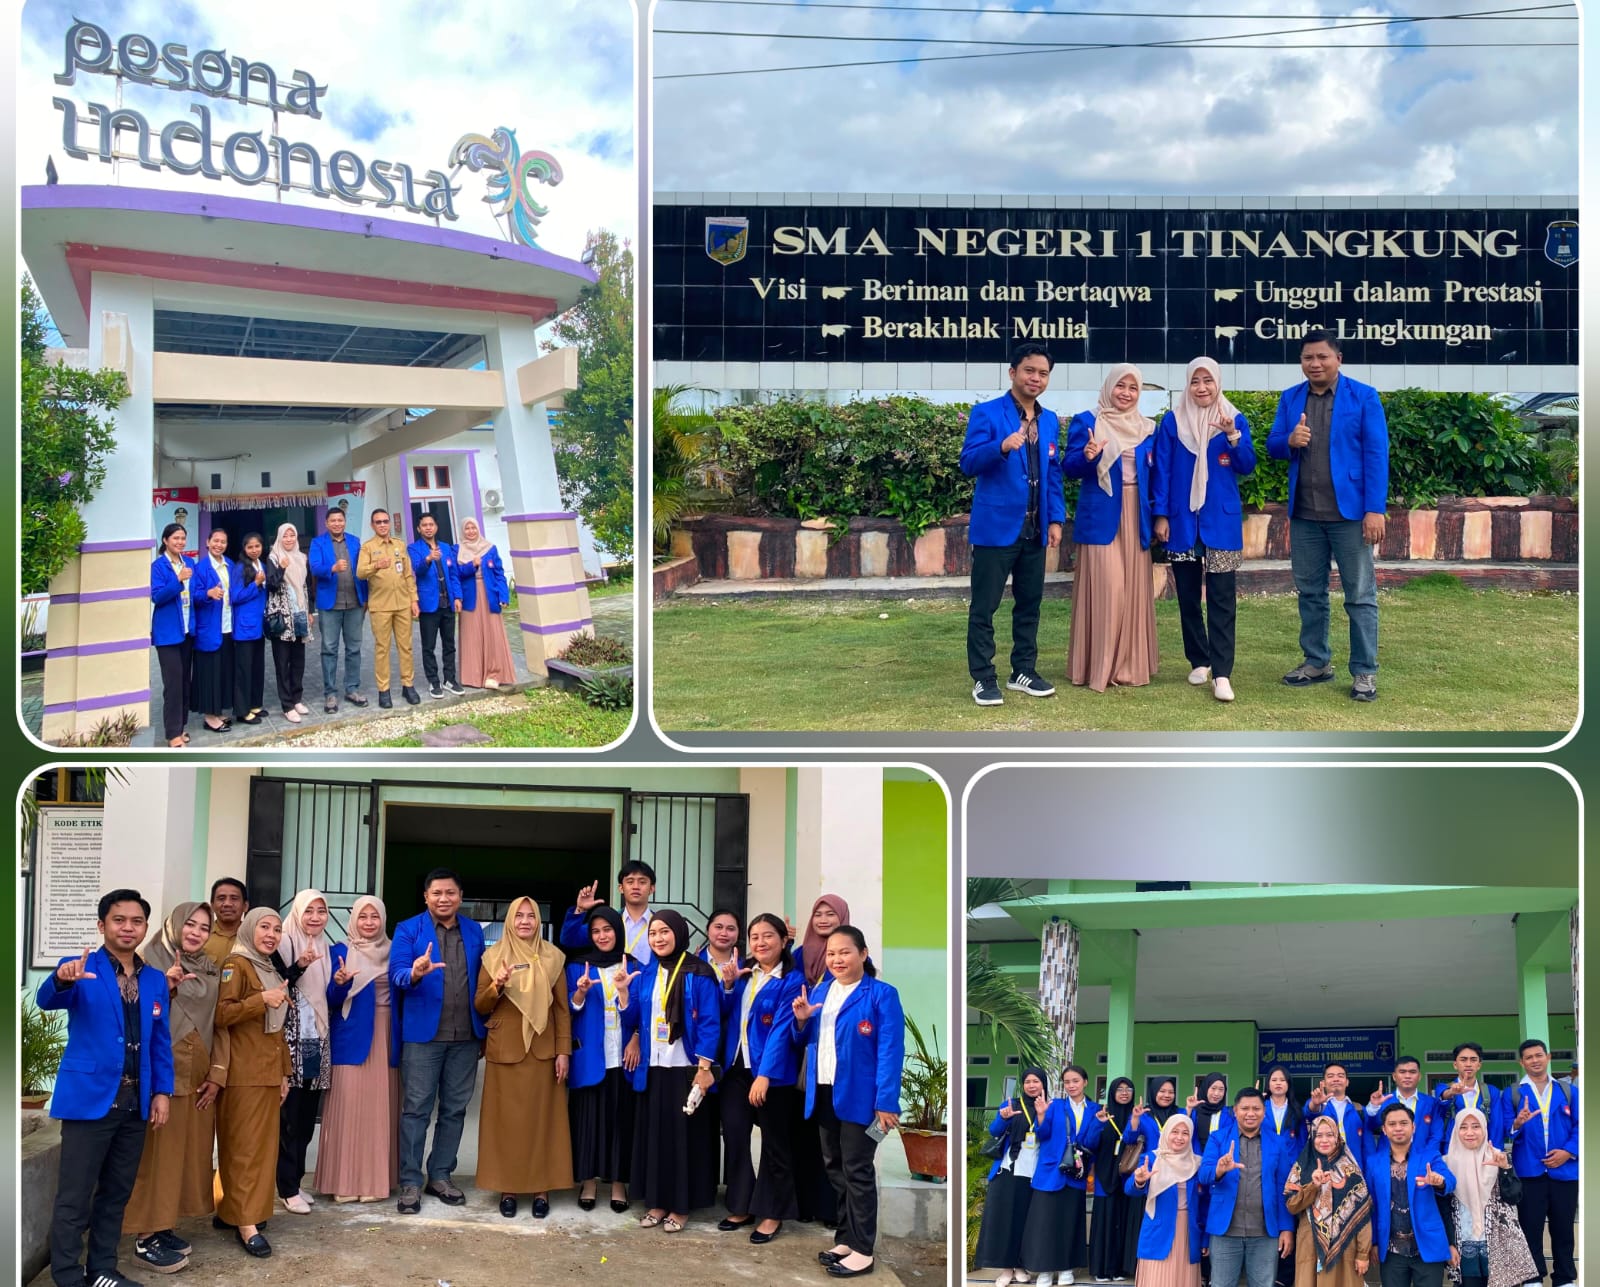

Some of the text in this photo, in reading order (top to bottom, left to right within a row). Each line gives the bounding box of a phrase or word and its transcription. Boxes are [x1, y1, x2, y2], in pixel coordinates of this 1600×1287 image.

[54, 16, 328, 119] pesona
[772, 226, 1522, 258] SMA NEGERI 1 TINANGKUNG
[750, 277, 807, 301] Visi
[862, 278, 1152, 307] Beriman dan Bertaqwa
[1254, 280, 1542, 309] Unggul dalam Prestasi
[862, 316, 1088, 339] Berakhlak Mulia
[1336, 318, 1492, 346] Lingkungan
[1277, 1051, 1374, 1062] SMA NEGERI 1 TINANGKUNG
